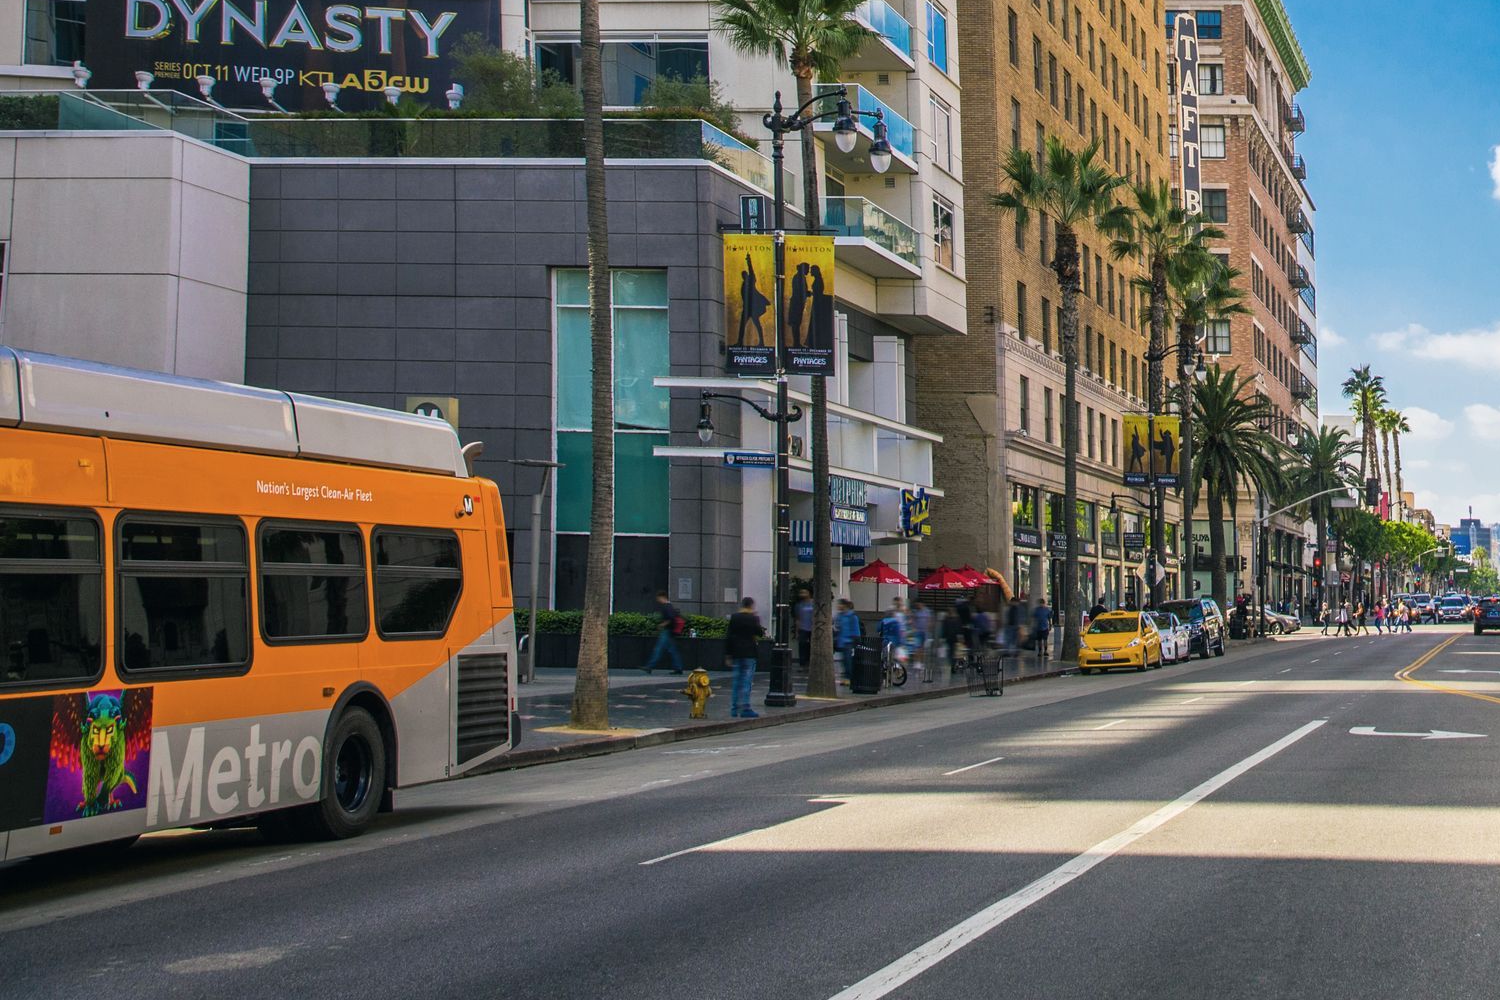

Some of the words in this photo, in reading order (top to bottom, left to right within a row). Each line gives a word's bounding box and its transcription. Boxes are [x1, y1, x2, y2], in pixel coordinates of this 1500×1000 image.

[154, 61, 181, 72] SERIES
[182, 63, 212, 80] OCT
[215, 65, 229, 81] 11
[233, 65, 270, 83] WED
[275, 68, 295, 85] 9P
[1180, 34, 1199, 168] TAFT
[256, 480, 290, 495] Nation's
[291, 482, 320, 500] Largest
[321, 485, 354, 500] Clean-Air
[356, 488, 373, 502] Fleet
[146, 723, 322, 828] Metro
